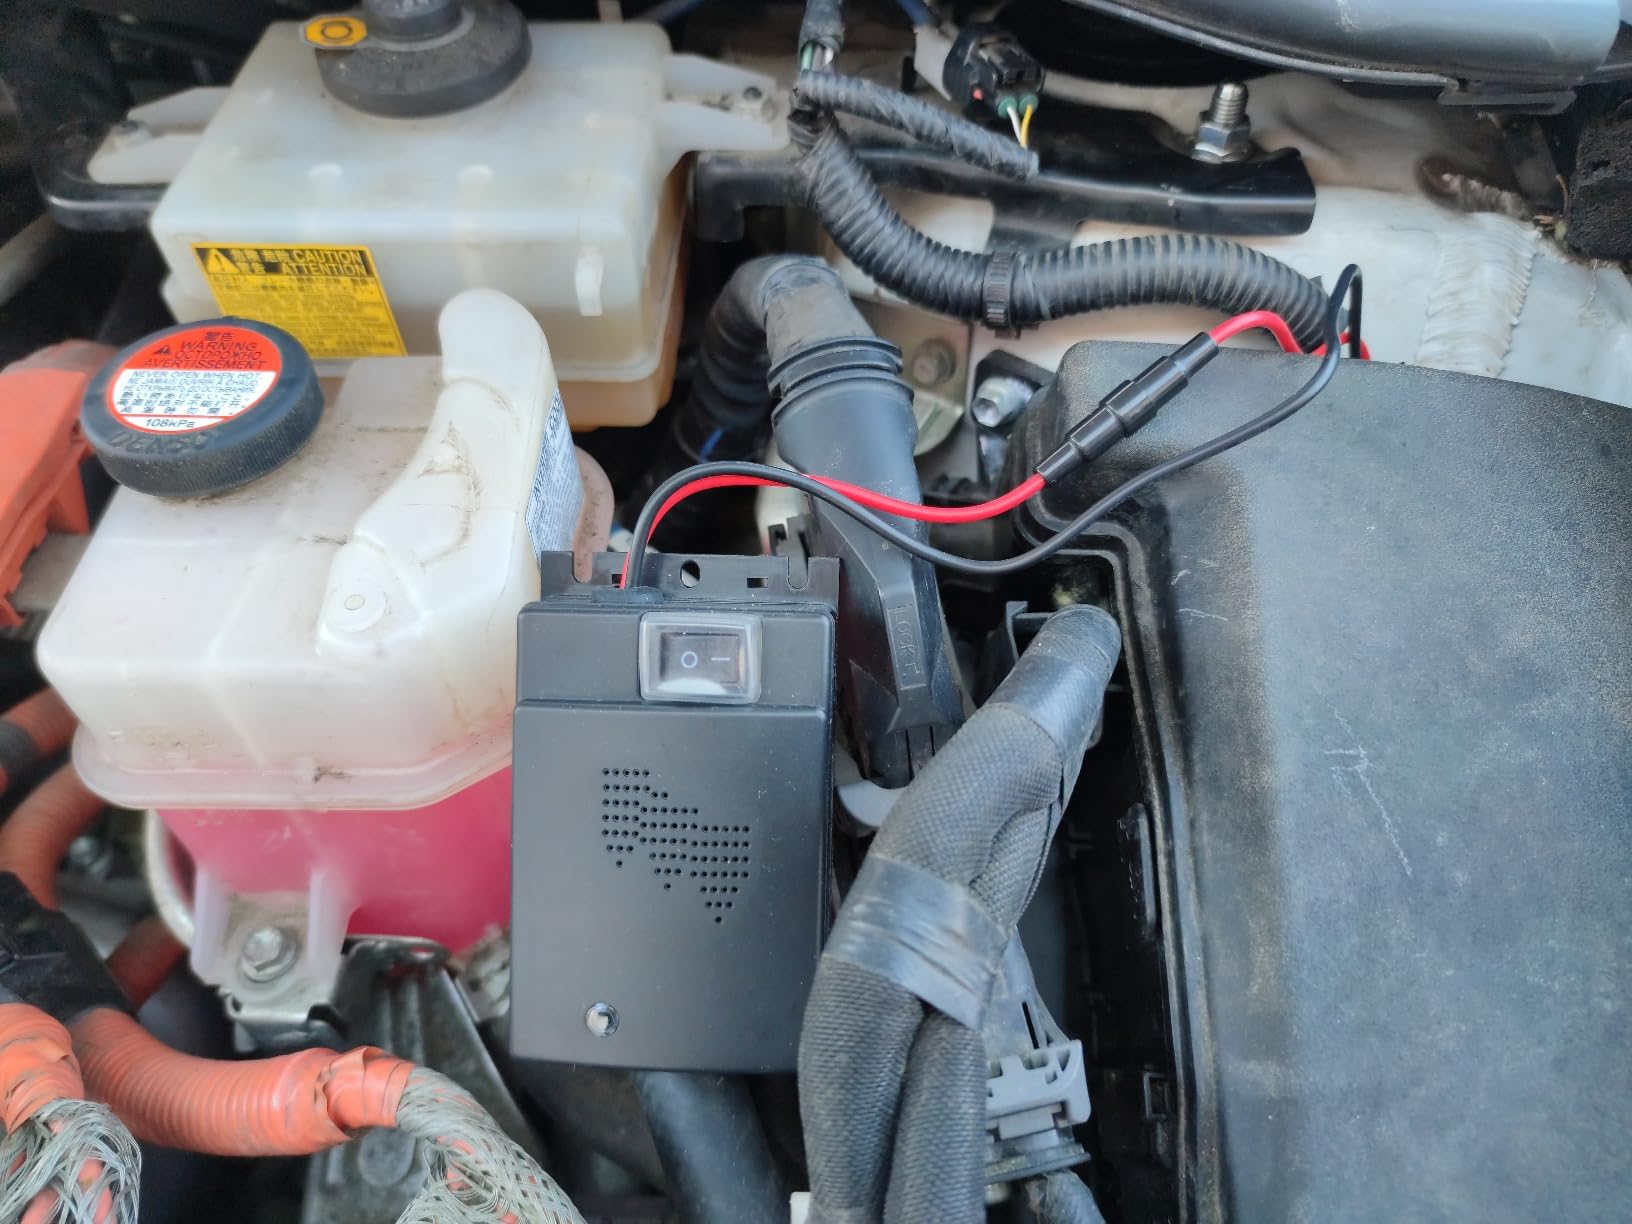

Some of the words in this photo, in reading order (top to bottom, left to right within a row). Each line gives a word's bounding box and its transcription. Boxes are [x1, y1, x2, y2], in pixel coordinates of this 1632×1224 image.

[293, 250, 361, 262] CAUTION
[282, 262, 367, 276] ATTENTION
[181, 341, 257, 351] WARNING
[144, 358, 267, 369] AVERTISSEMENT
[170, 371, 199, 379] OPEN
[203, 372, 235, 380] WHEN
[141, 378, 178, 386] JAMAIS
[145, 418, 196, 428] 108kPa
